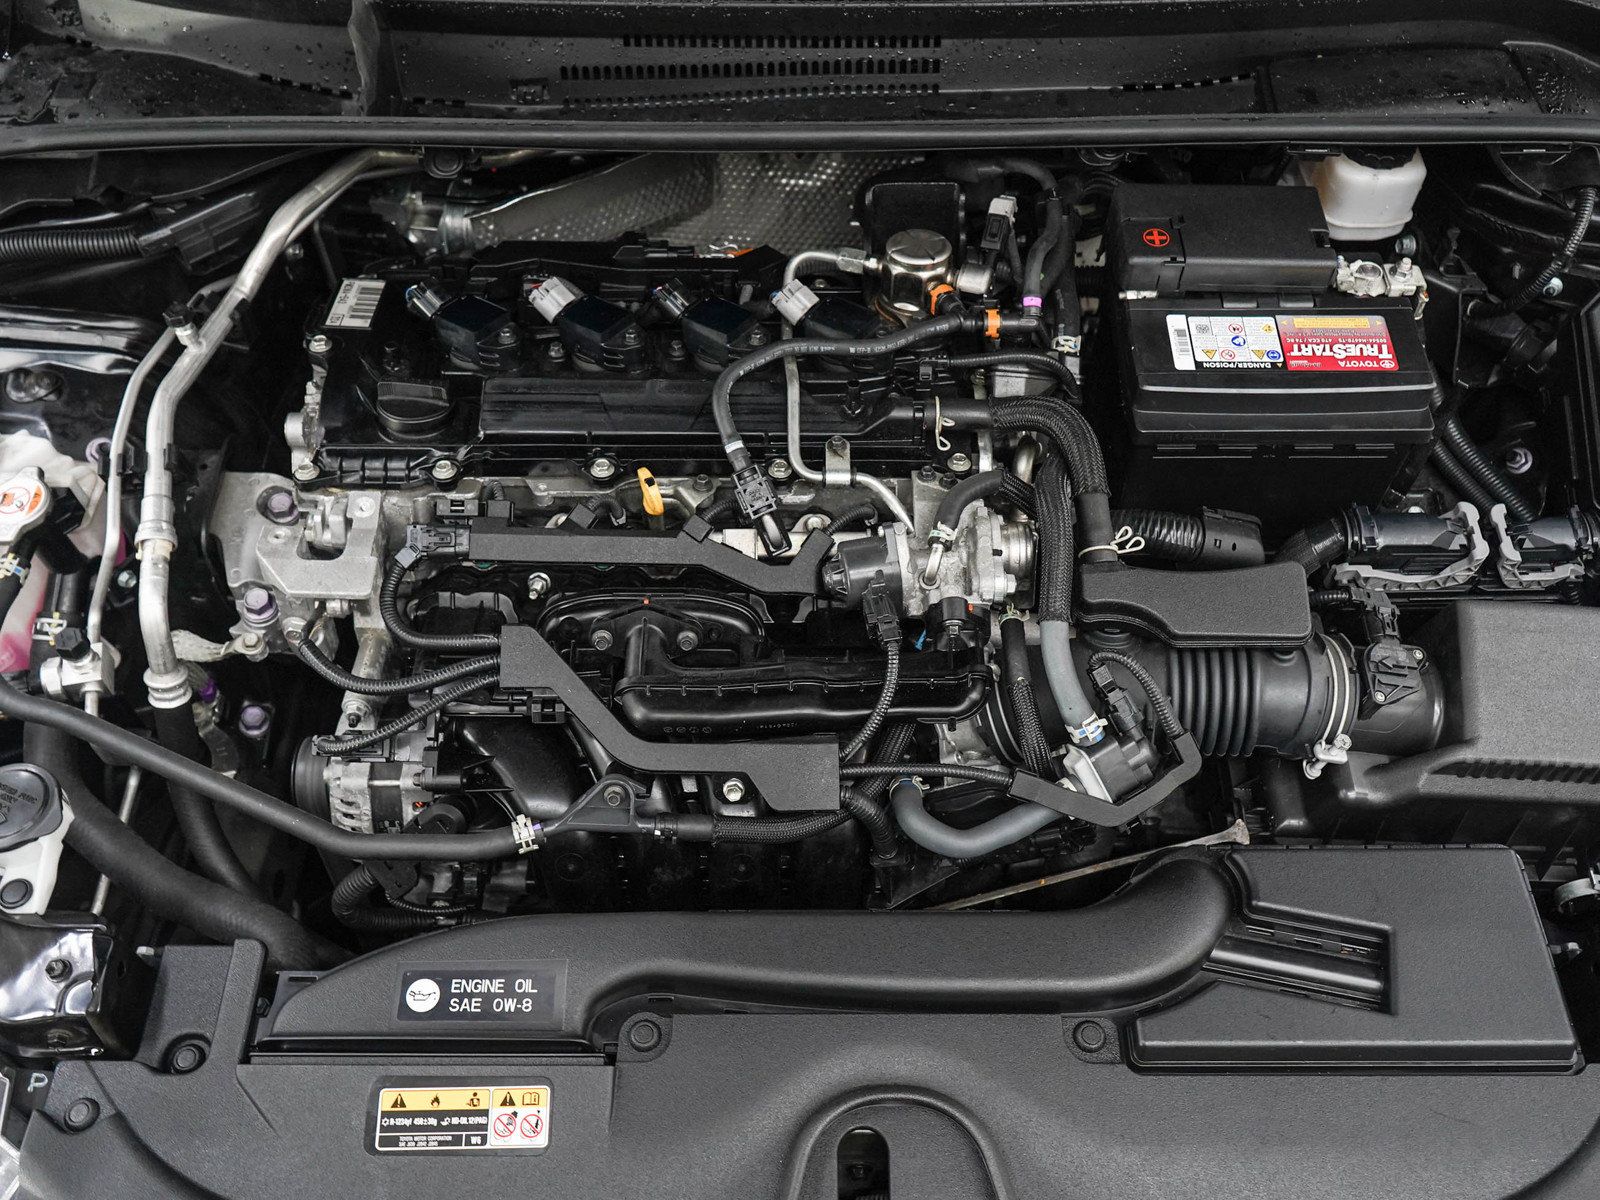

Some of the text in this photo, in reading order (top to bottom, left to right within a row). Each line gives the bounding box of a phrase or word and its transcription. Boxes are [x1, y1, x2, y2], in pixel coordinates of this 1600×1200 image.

[1338, 360, 1379, 368] TOYOTA
[450, 978, 538, 993] ENGINE OIL
[448, 997, 483, 1012] SAE
[27, 1072, 48, 1093] P
